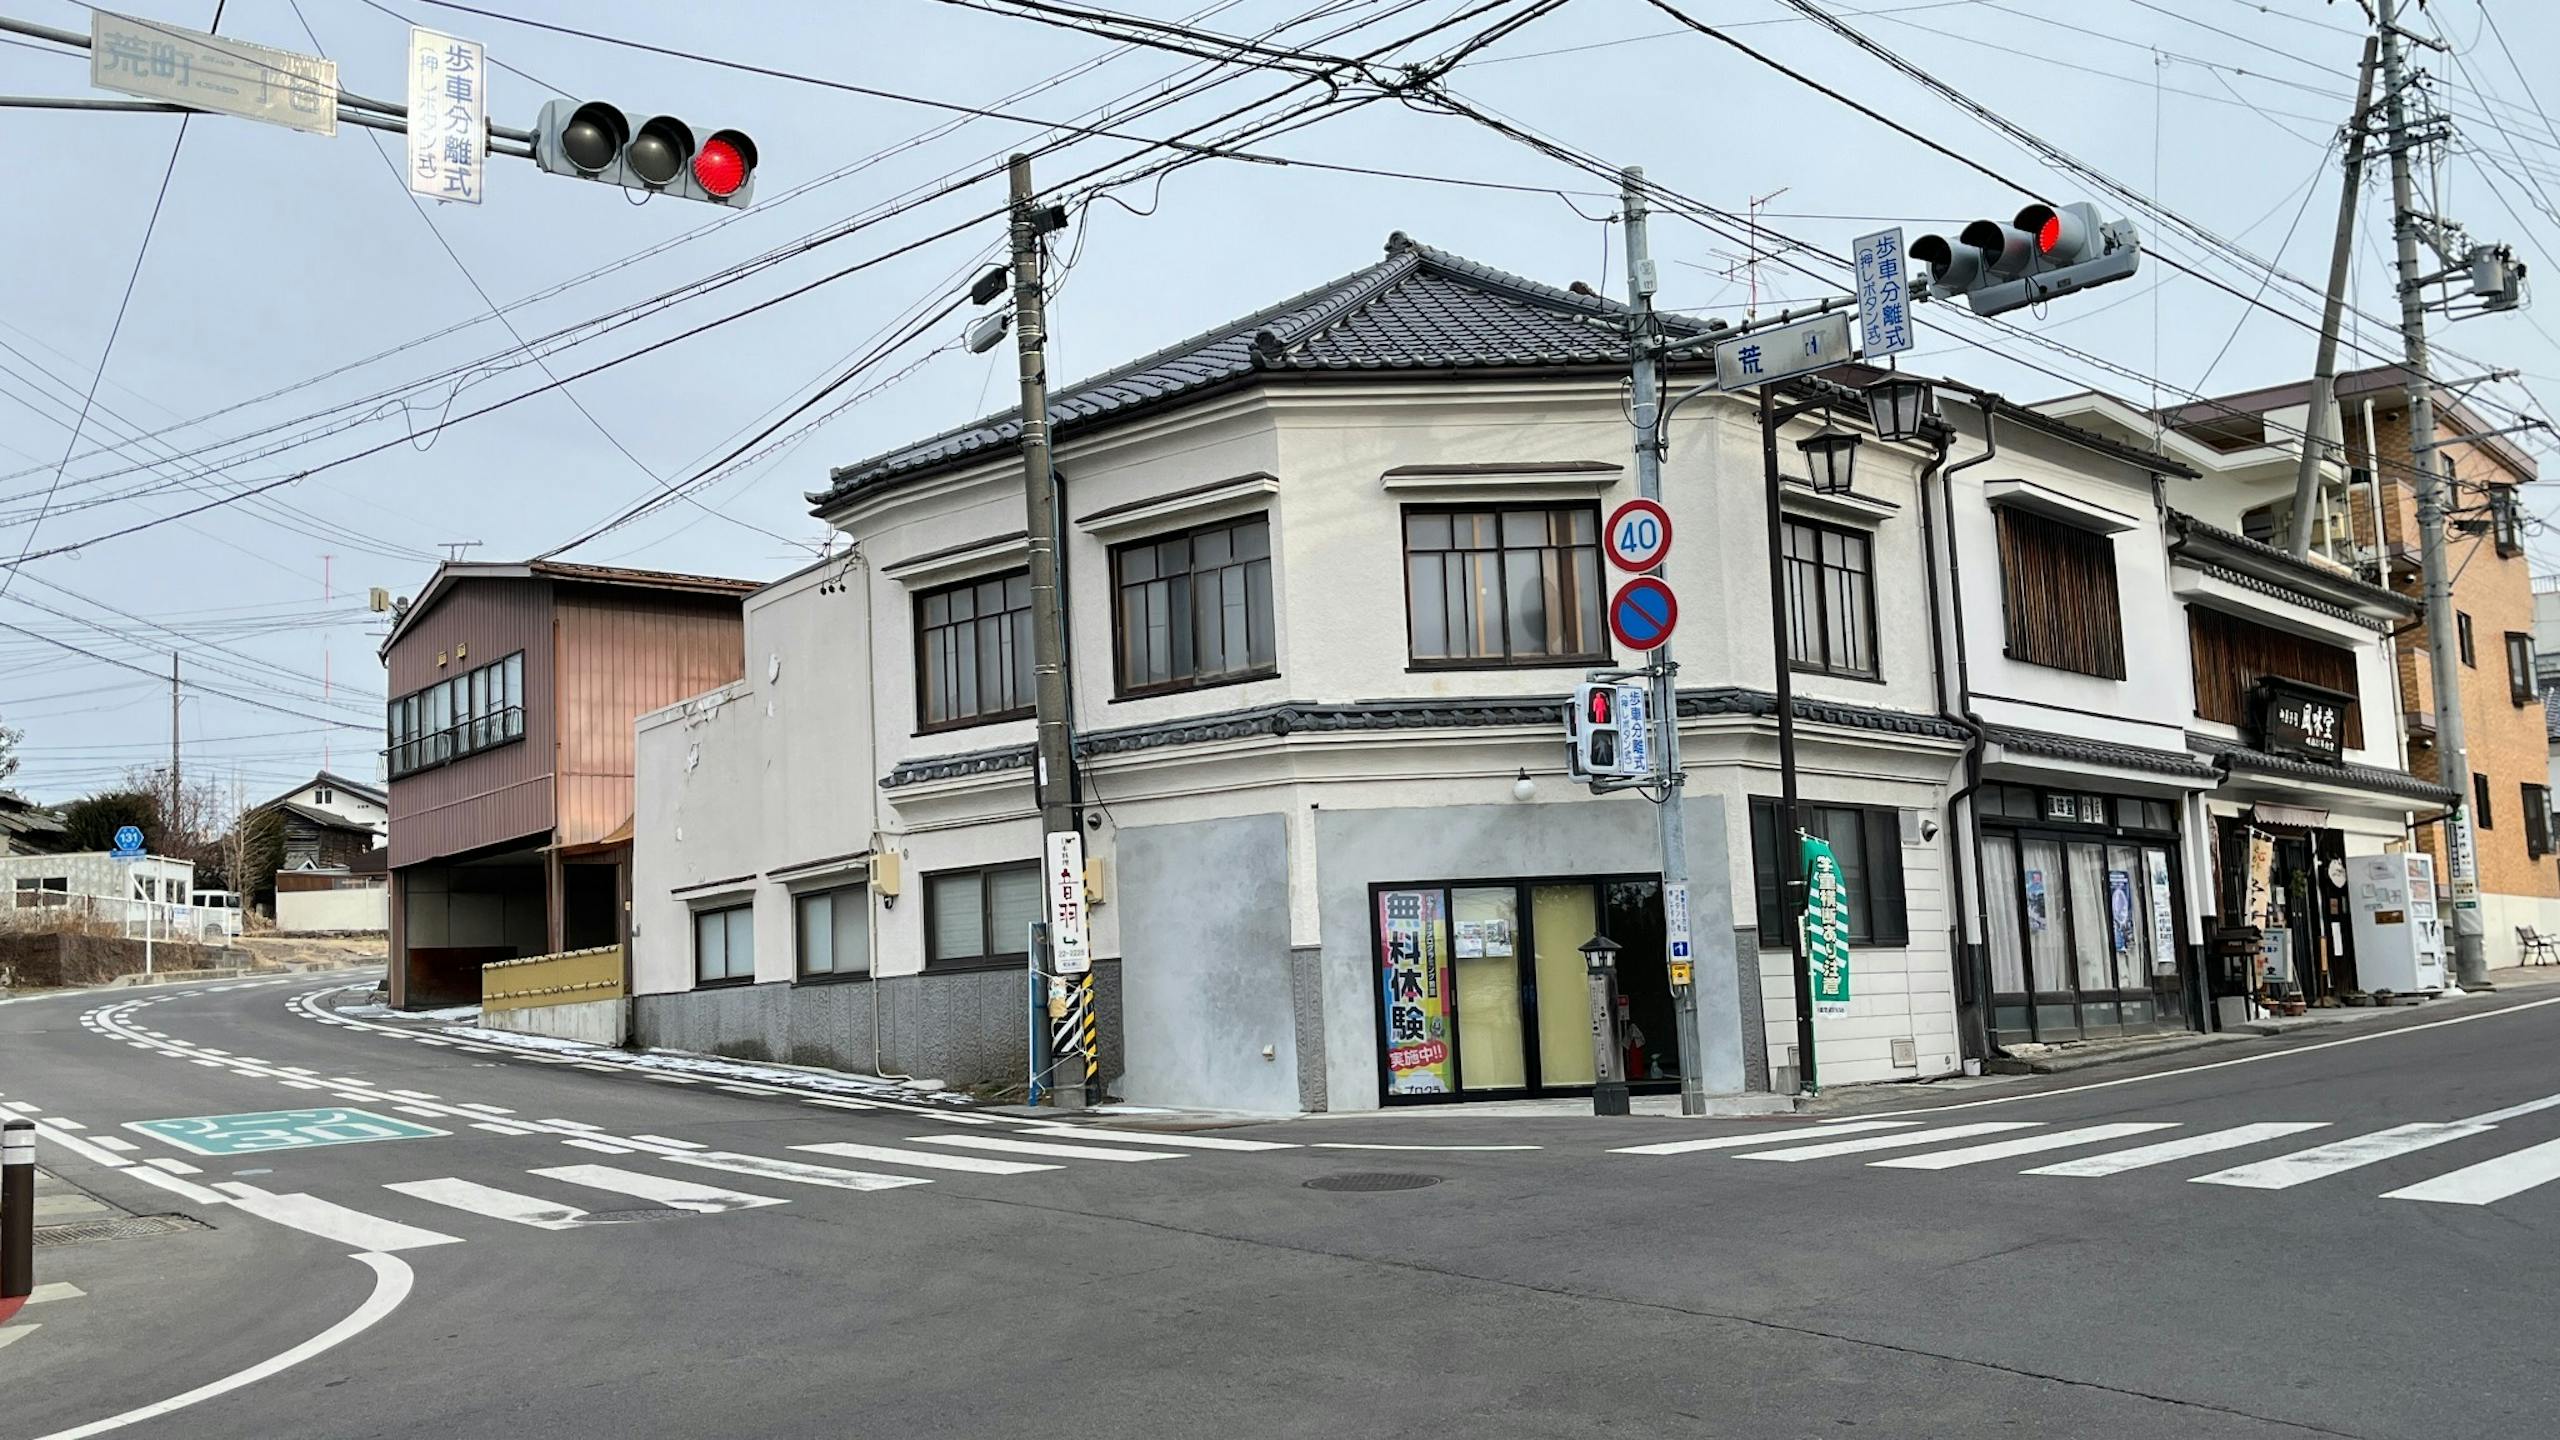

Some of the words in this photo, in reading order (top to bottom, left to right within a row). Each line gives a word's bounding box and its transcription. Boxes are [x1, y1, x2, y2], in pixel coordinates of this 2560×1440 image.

[443, 44, 474, 198] 歩車分離式
[1876, 235, 1906, 349] 歩車分離式
[1620, 518, 1658, 553] 40
[1630, 691, 1646, 770] 歩車分離式
[119, 831, 138, 843] 131
[1387, 894, 1426, 1041] 無料体験
[205, 1123, 404, 1148] 30
